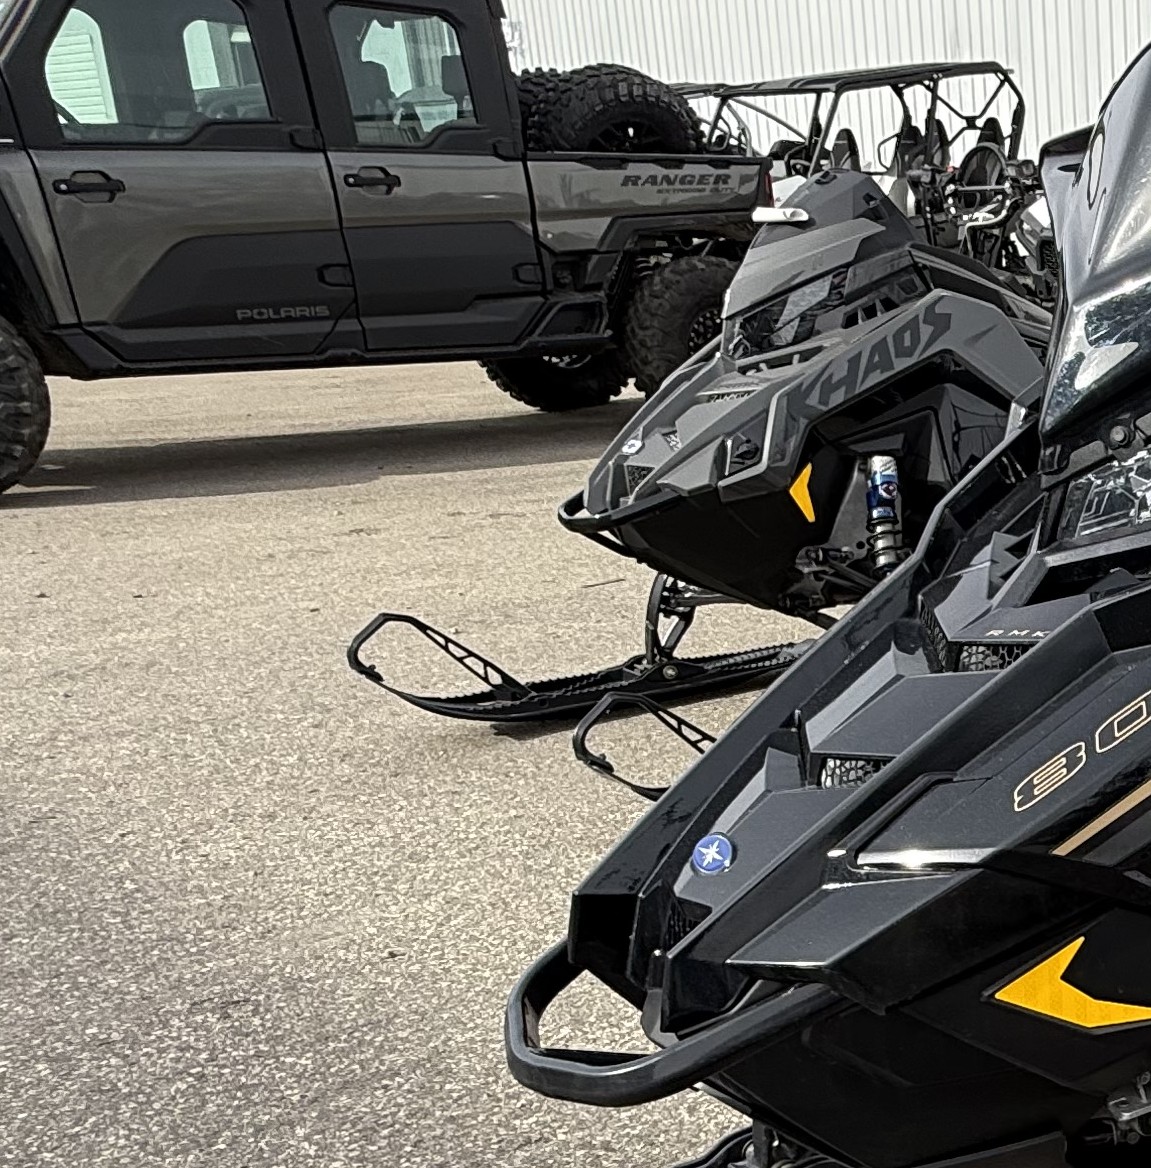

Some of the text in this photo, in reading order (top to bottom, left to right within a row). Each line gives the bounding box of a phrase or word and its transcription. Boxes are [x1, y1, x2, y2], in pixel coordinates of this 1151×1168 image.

[621, 174, 731, 187] RANGER
[236, 306, 330, 320] POLARIS
[786, 294, 952, 422] KHAOS
[983, 629, 1052, 638] RMK
